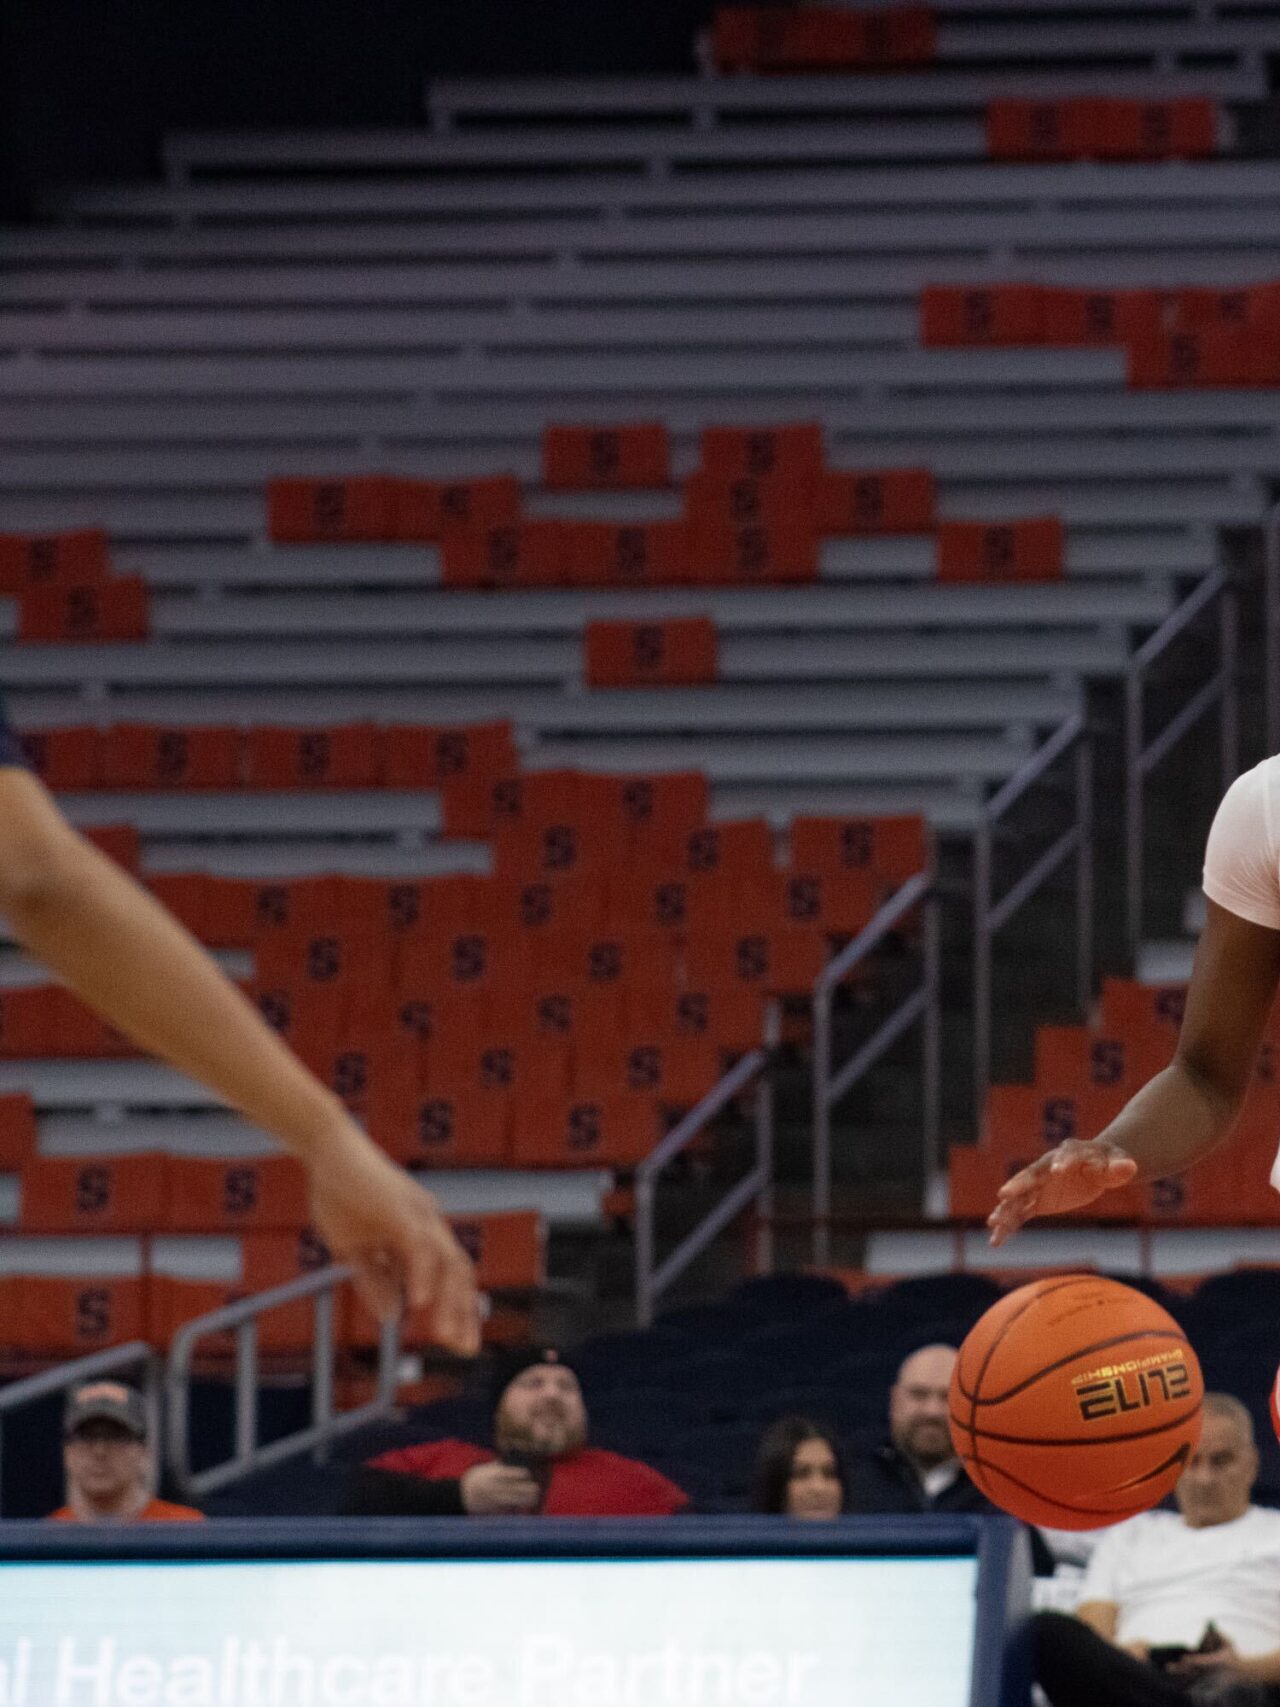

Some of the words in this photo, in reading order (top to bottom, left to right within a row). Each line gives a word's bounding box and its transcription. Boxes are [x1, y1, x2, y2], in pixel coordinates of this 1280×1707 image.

[308, 939, 339, 980] S
[453, 937, 485, 981] S
[736, 938, 768, 979] S
[1090, 1039, 1124, 1085] S
[419, 1100, 452, 1148] S
[568, 1105, 600, 1151] S
[1042, 1099, 1076, 1146] S
[76, 1165, 110, 1213] S
[224, 1166, 257, 1216] S
[77, 1287, 110, 1339] S
[1076, 1364, 1191, 1421] ELITE
[56, 1635, 494, 1706] Healthcare
[518, 1632, 819, 1706] Partner
